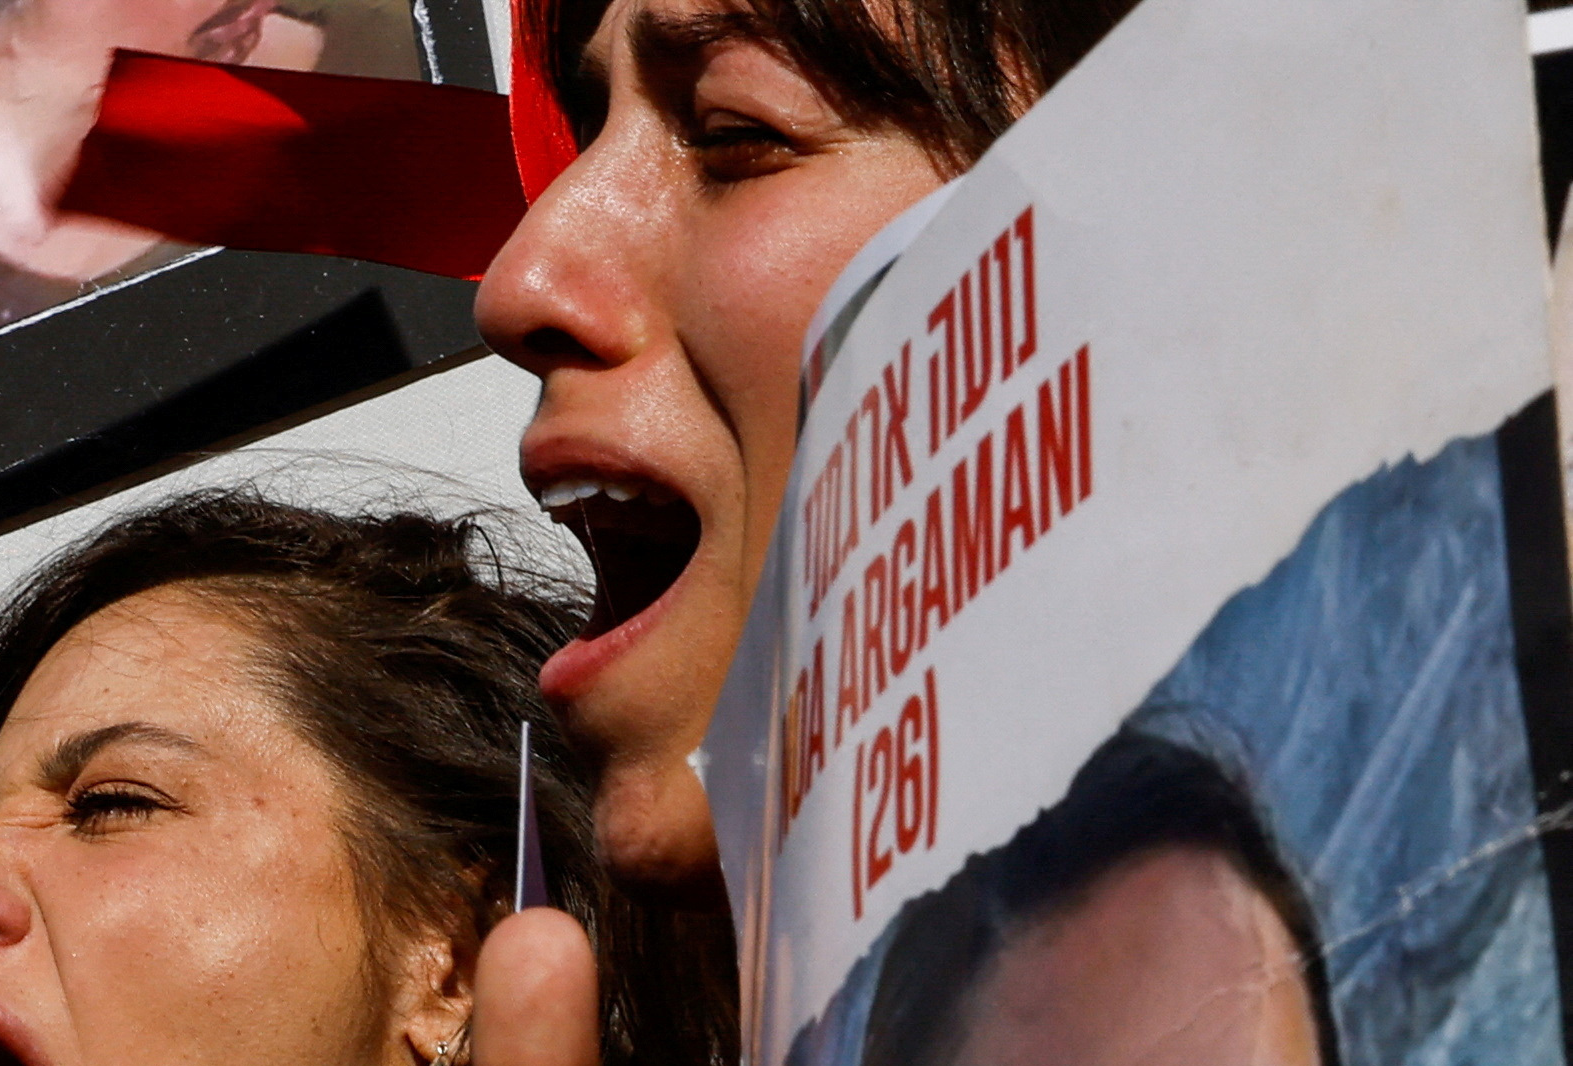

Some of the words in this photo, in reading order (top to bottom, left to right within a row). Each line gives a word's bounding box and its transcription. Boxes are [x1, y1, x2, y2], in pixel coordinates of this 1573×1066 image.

[927, 203, 1037, 457] נועה
[834, 341, 1093, 750] ARGAMANI
[851, 664, 939, 922] (26)
